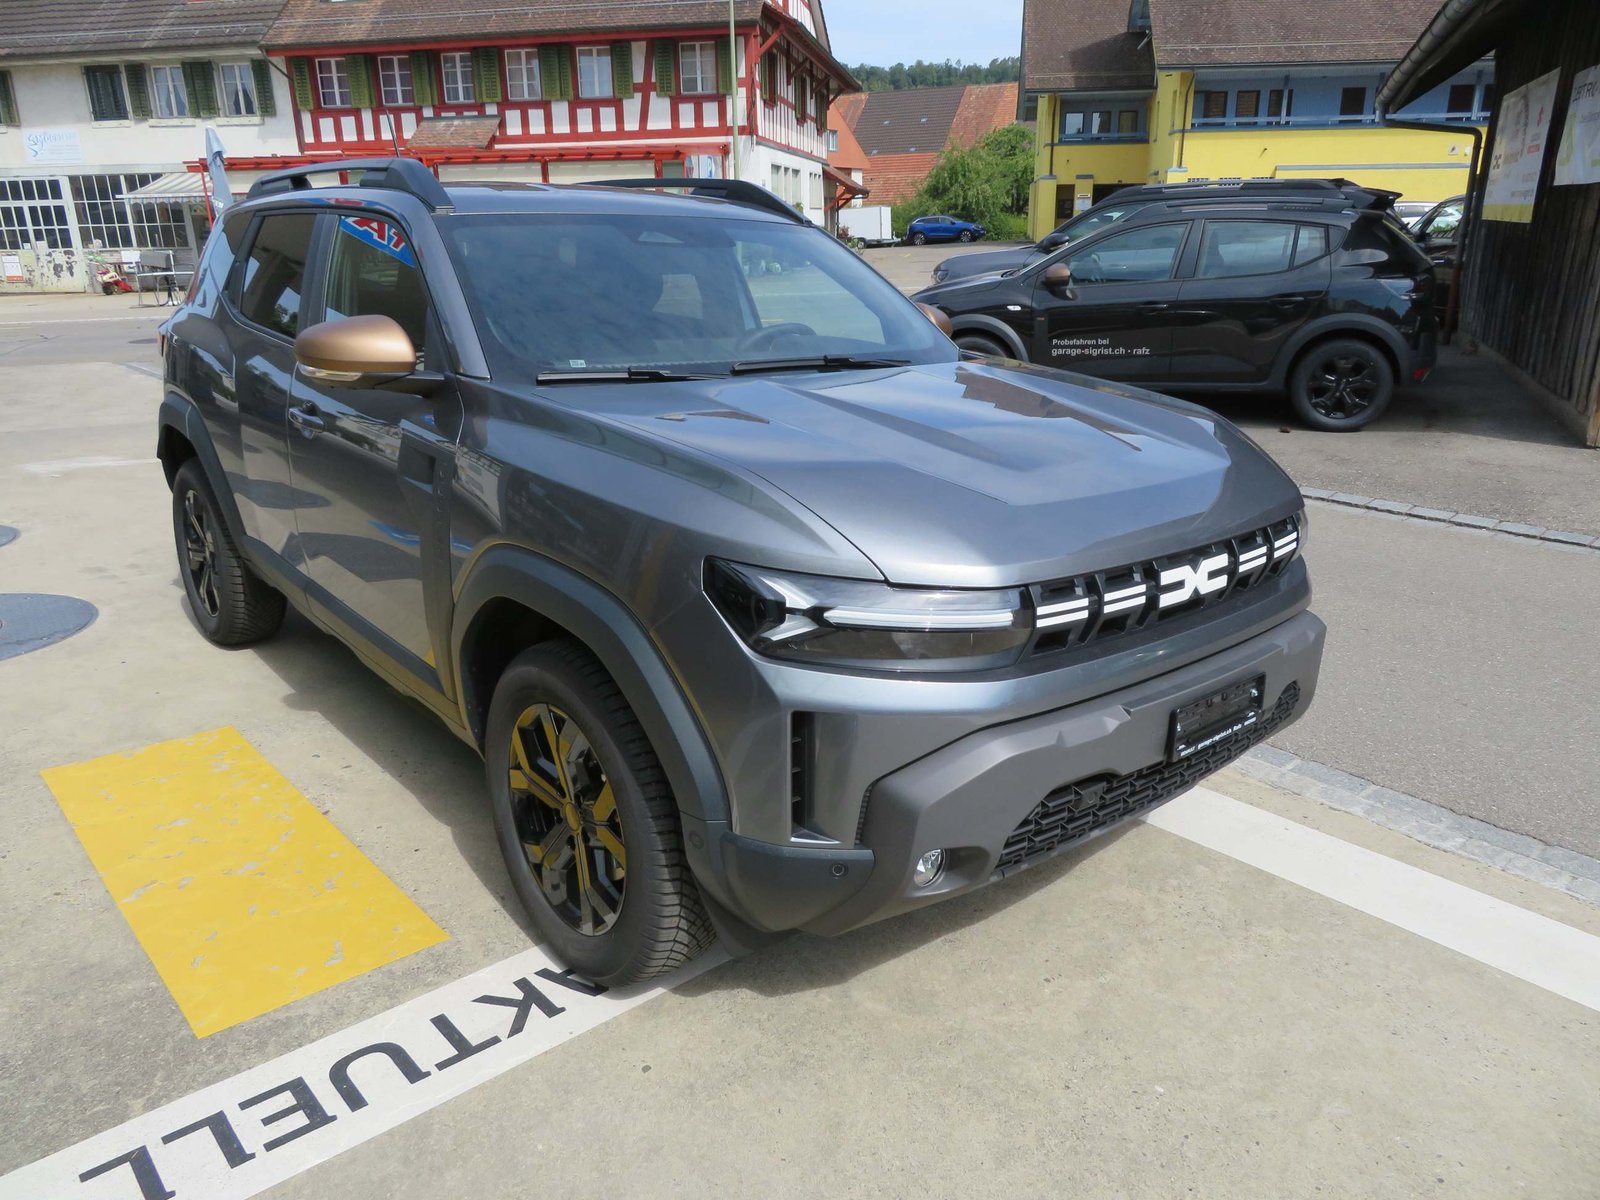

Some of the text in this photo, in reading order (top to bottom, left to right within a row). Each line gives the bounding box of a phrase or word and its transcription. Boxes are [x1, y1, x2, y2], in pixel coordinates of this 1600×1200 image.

[1052, 338, 1096, 346] Probefahren
[1051, 346, 1150, 356] garage-sigrist.ch rafz
